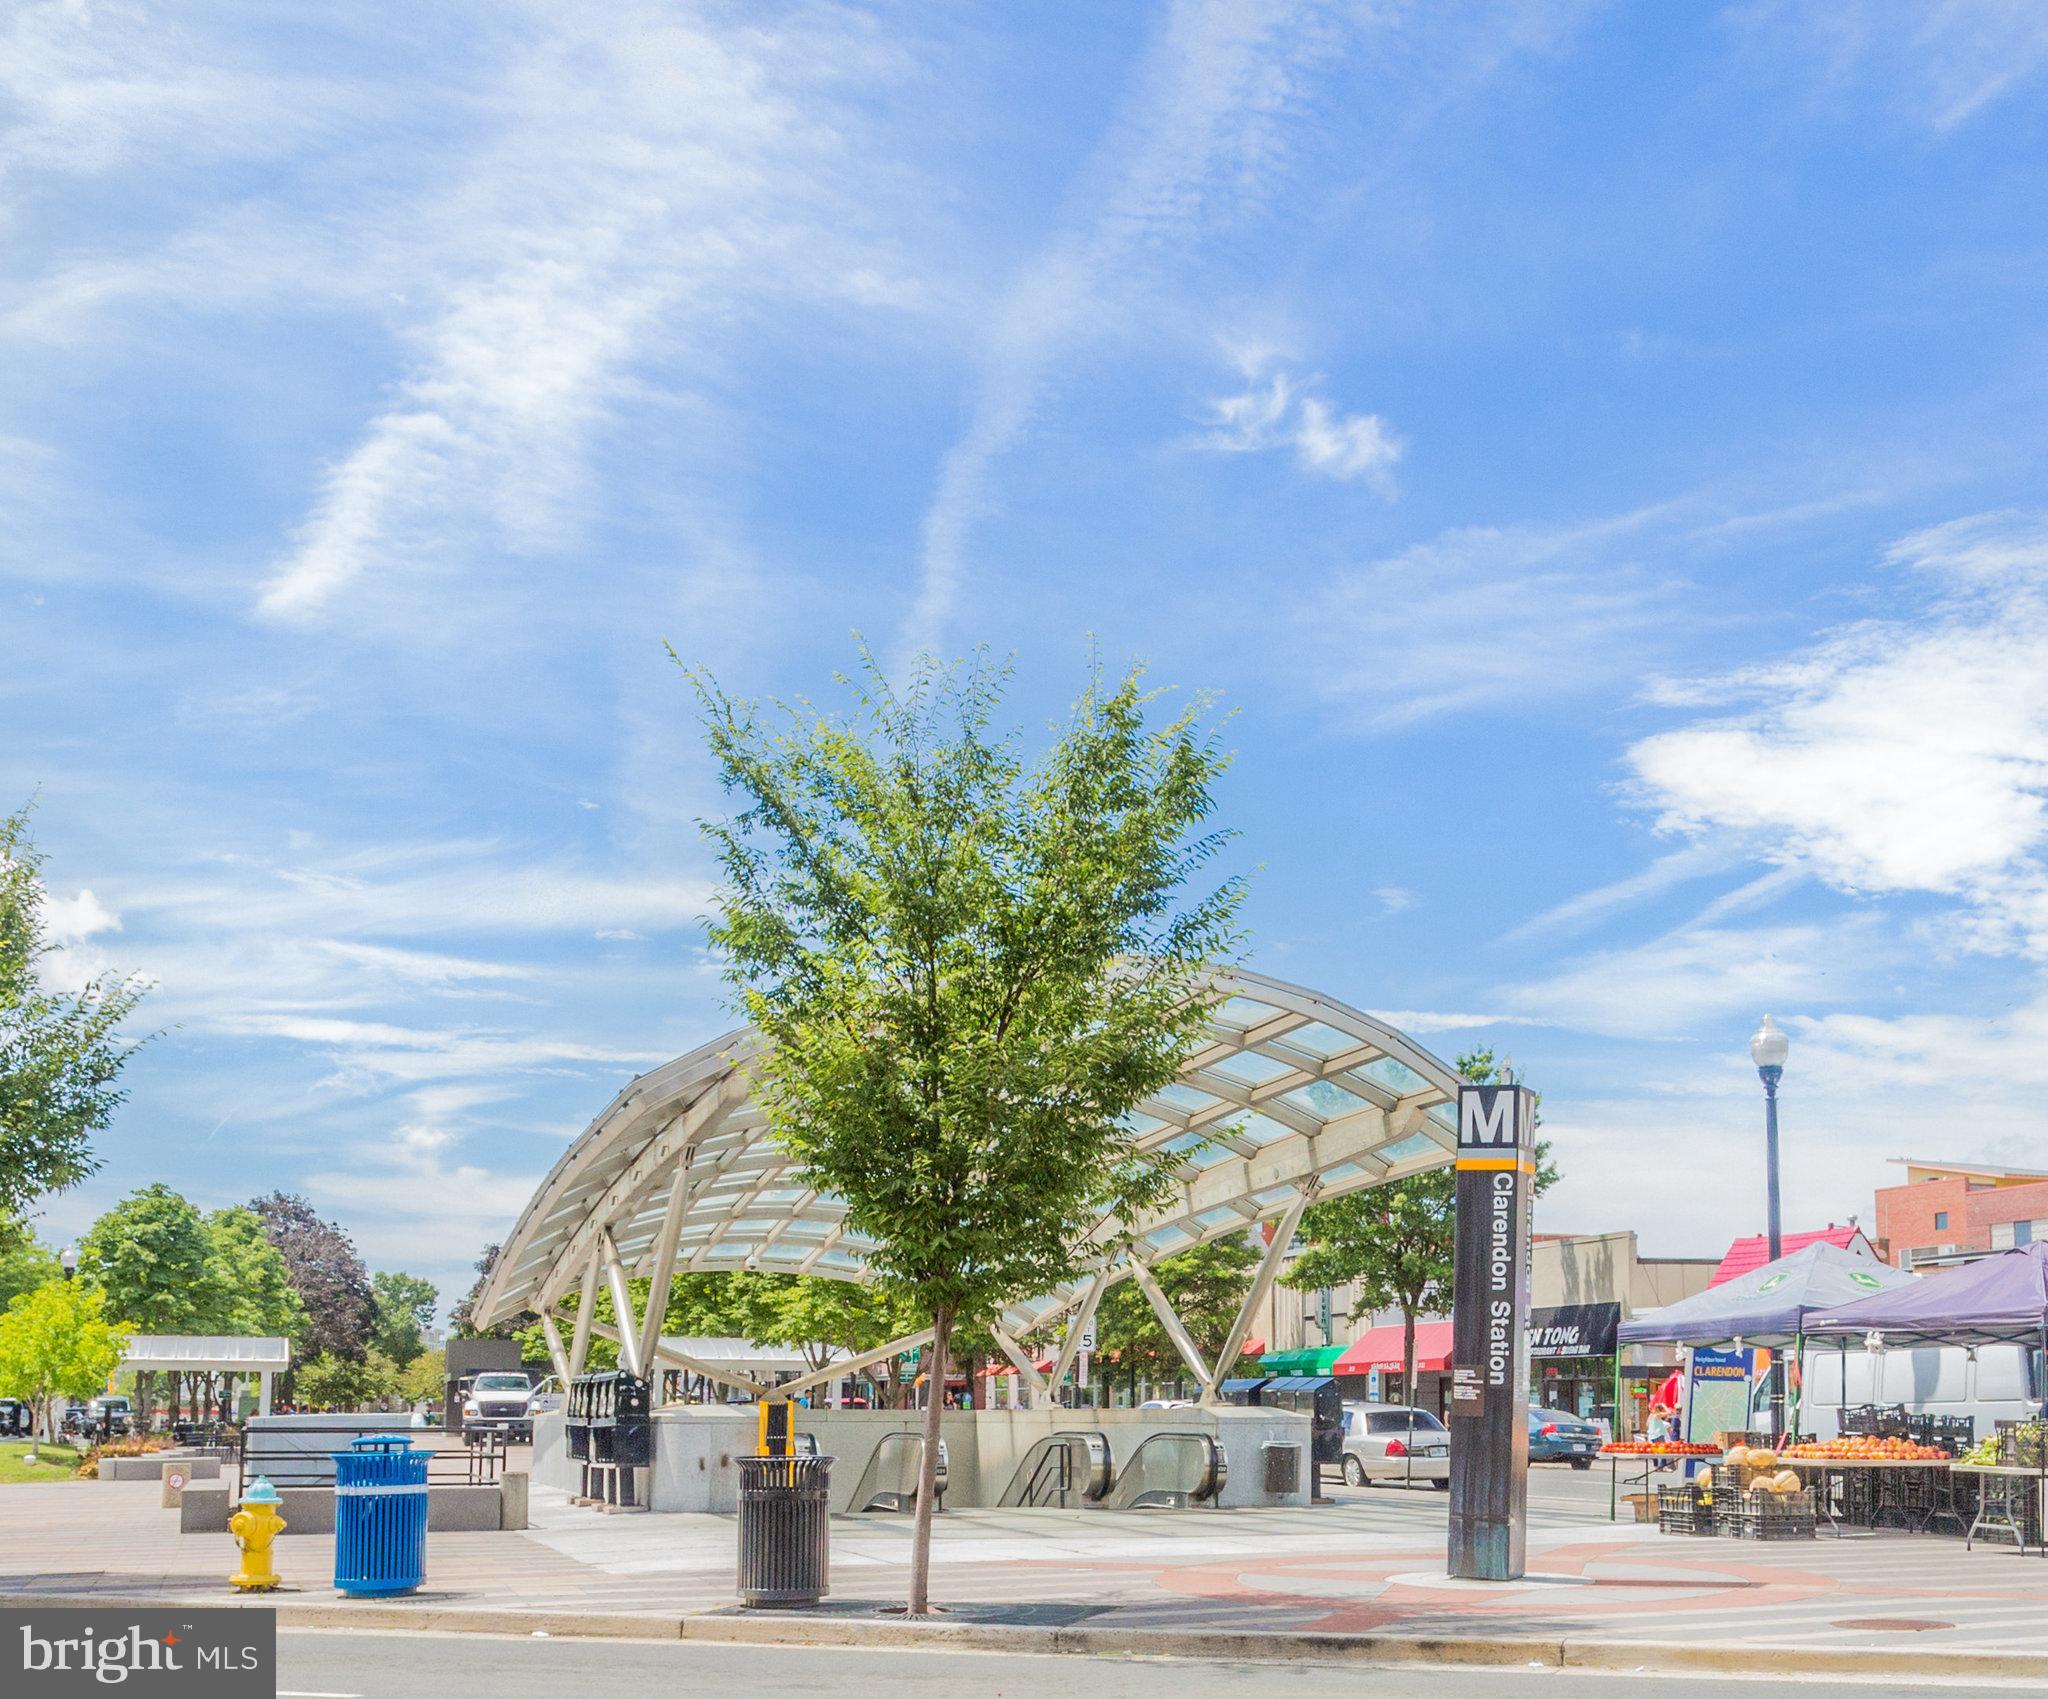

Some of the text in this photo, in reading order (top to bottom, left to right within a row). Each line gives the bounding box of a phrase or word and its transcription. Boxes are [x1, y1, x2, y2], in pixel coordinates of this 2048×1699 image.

[1461, 1091, 1514, 1144] M
[1519, 1092, 1535, 1147] M
[1489, 1172, 1513, 1386] Clarendon Station
[1543, 1326, 1580, 1345] TONG
[1694, 1366, 1745, 1377] CLARENDON
